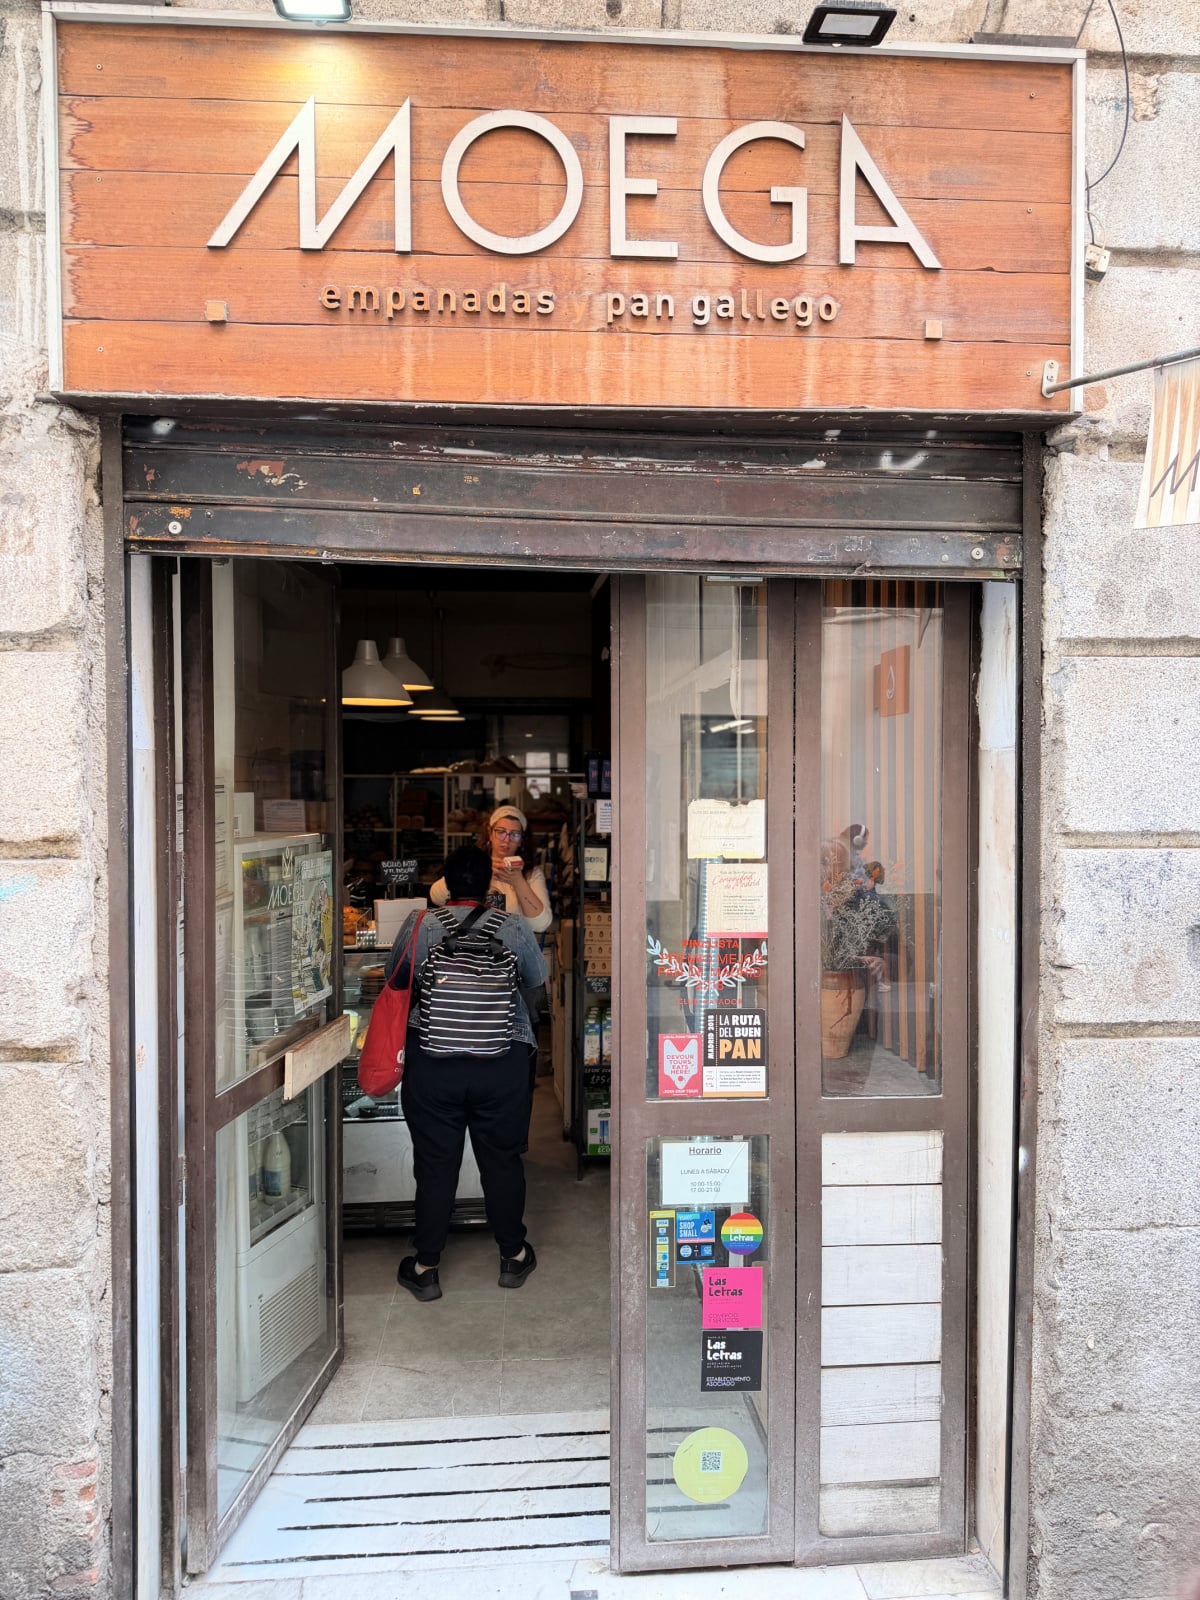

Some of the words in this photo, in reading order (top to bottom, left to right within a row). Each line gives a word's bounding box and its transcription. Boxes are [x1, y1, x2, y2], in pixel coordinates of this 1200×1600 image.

[207, 95, 942, 270] MOEGA
[320, 282, 555, 319] empanadas
[607, 292, 675, 324] pan
[692, 288, 838, 327] gallego
[682, 939, 739, 948] FINALISTA
[719, 1015, 730, 1026] LA
[732, 1014, 761, 1026] RUTA
[719, 1027, 733, 1038] DEL
[734, 1027, 761, 1038] BUEN
[707, 1032, 715, 1060] MADRID
[719, 1039, 761, 1059] PAN
[689, 1146, 722, 1154] Horario
[679, 1222, 695, 1230] SHOP
[729, 1226, 743, 1234] Las
[679, 1229, 698, 1237] SMALL
[729, 1233, 754, 1242] Letras
[708, 1276, 727, 1286] Las
[708, 1287, 743, 1296] Letras
[707, 1339, 726, 1349] Las
[706, 1350, 743, 1360] Letras
